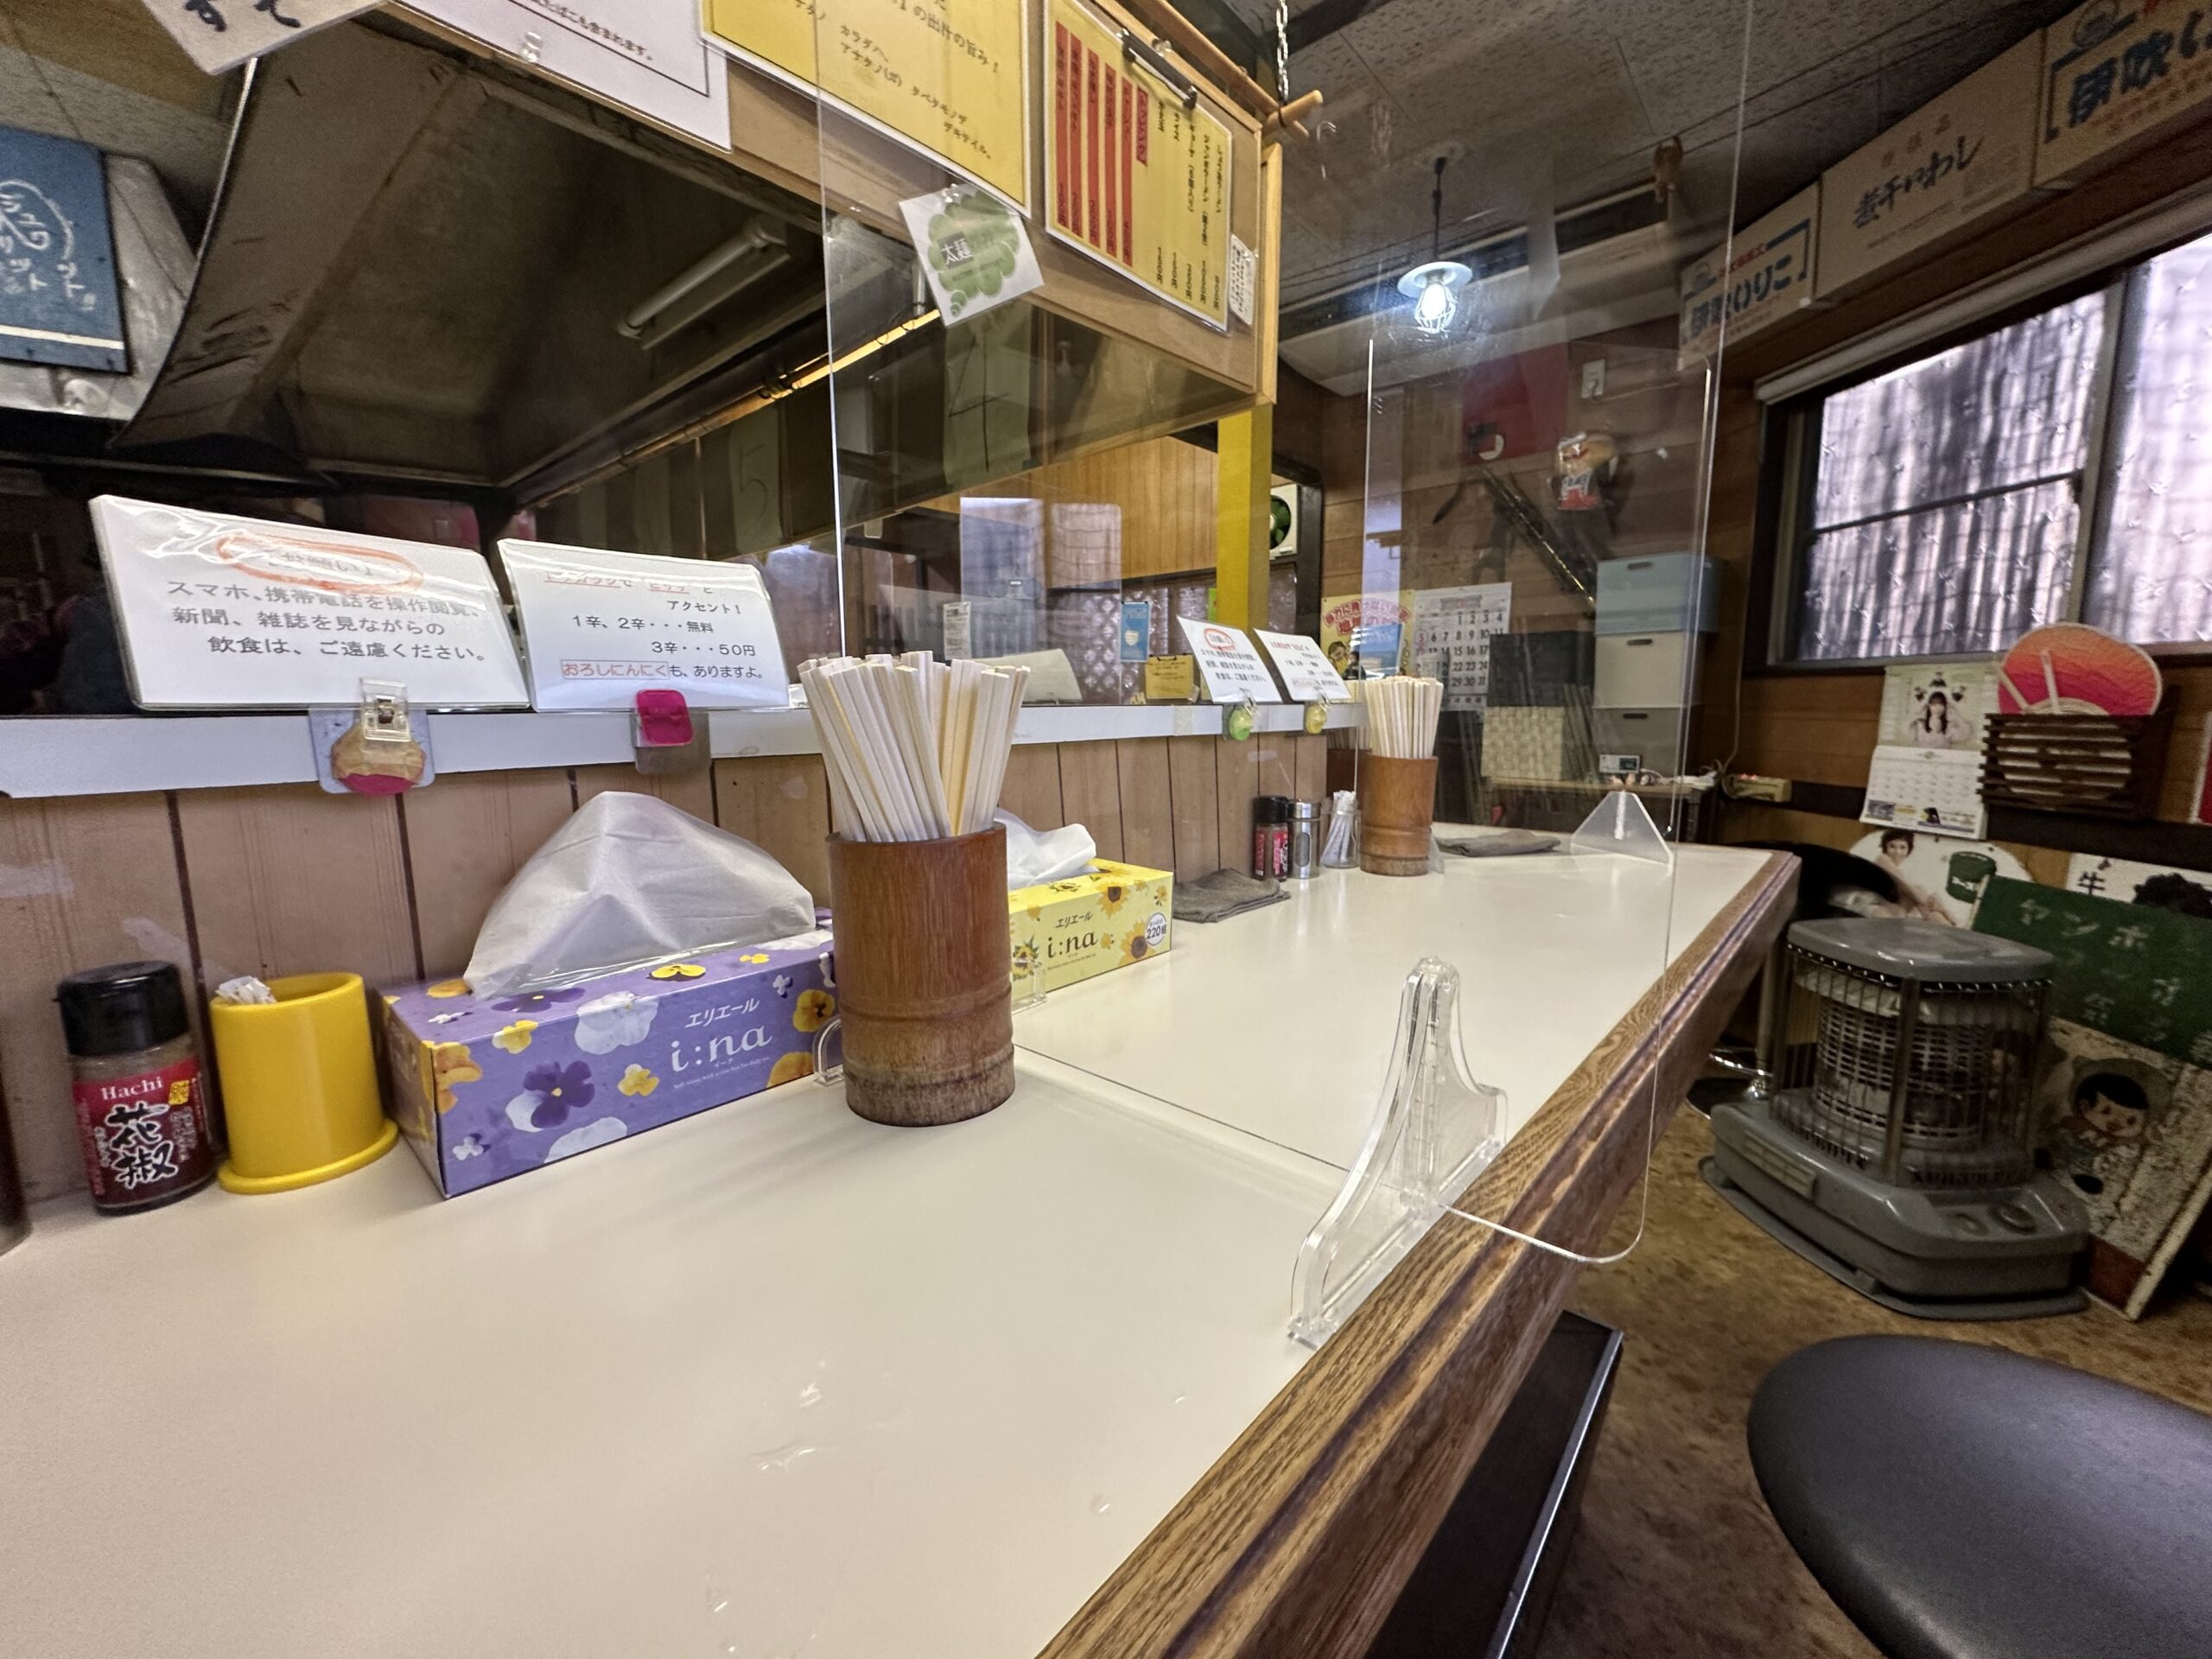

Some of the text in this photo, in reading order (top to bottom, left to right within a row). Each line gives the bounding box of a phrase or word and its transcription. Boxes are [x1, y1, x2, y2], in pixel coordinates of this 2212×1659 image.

[172, 607, 446, 638] 新聞、雑誌を見ながらの
[207, 635, 487, 663] 飲食は、ご遠慮ください。
[1055, 911, 1093, 929] エリエール
[1047, 931, 1098, 959] i:na
[684, 998, 760, 1028] エリエール
[671, 1025, 772, 1072] i:na
[99, 1076, 164, 1102] Hachi
[105, 1099, 180, 1190] 花椒
